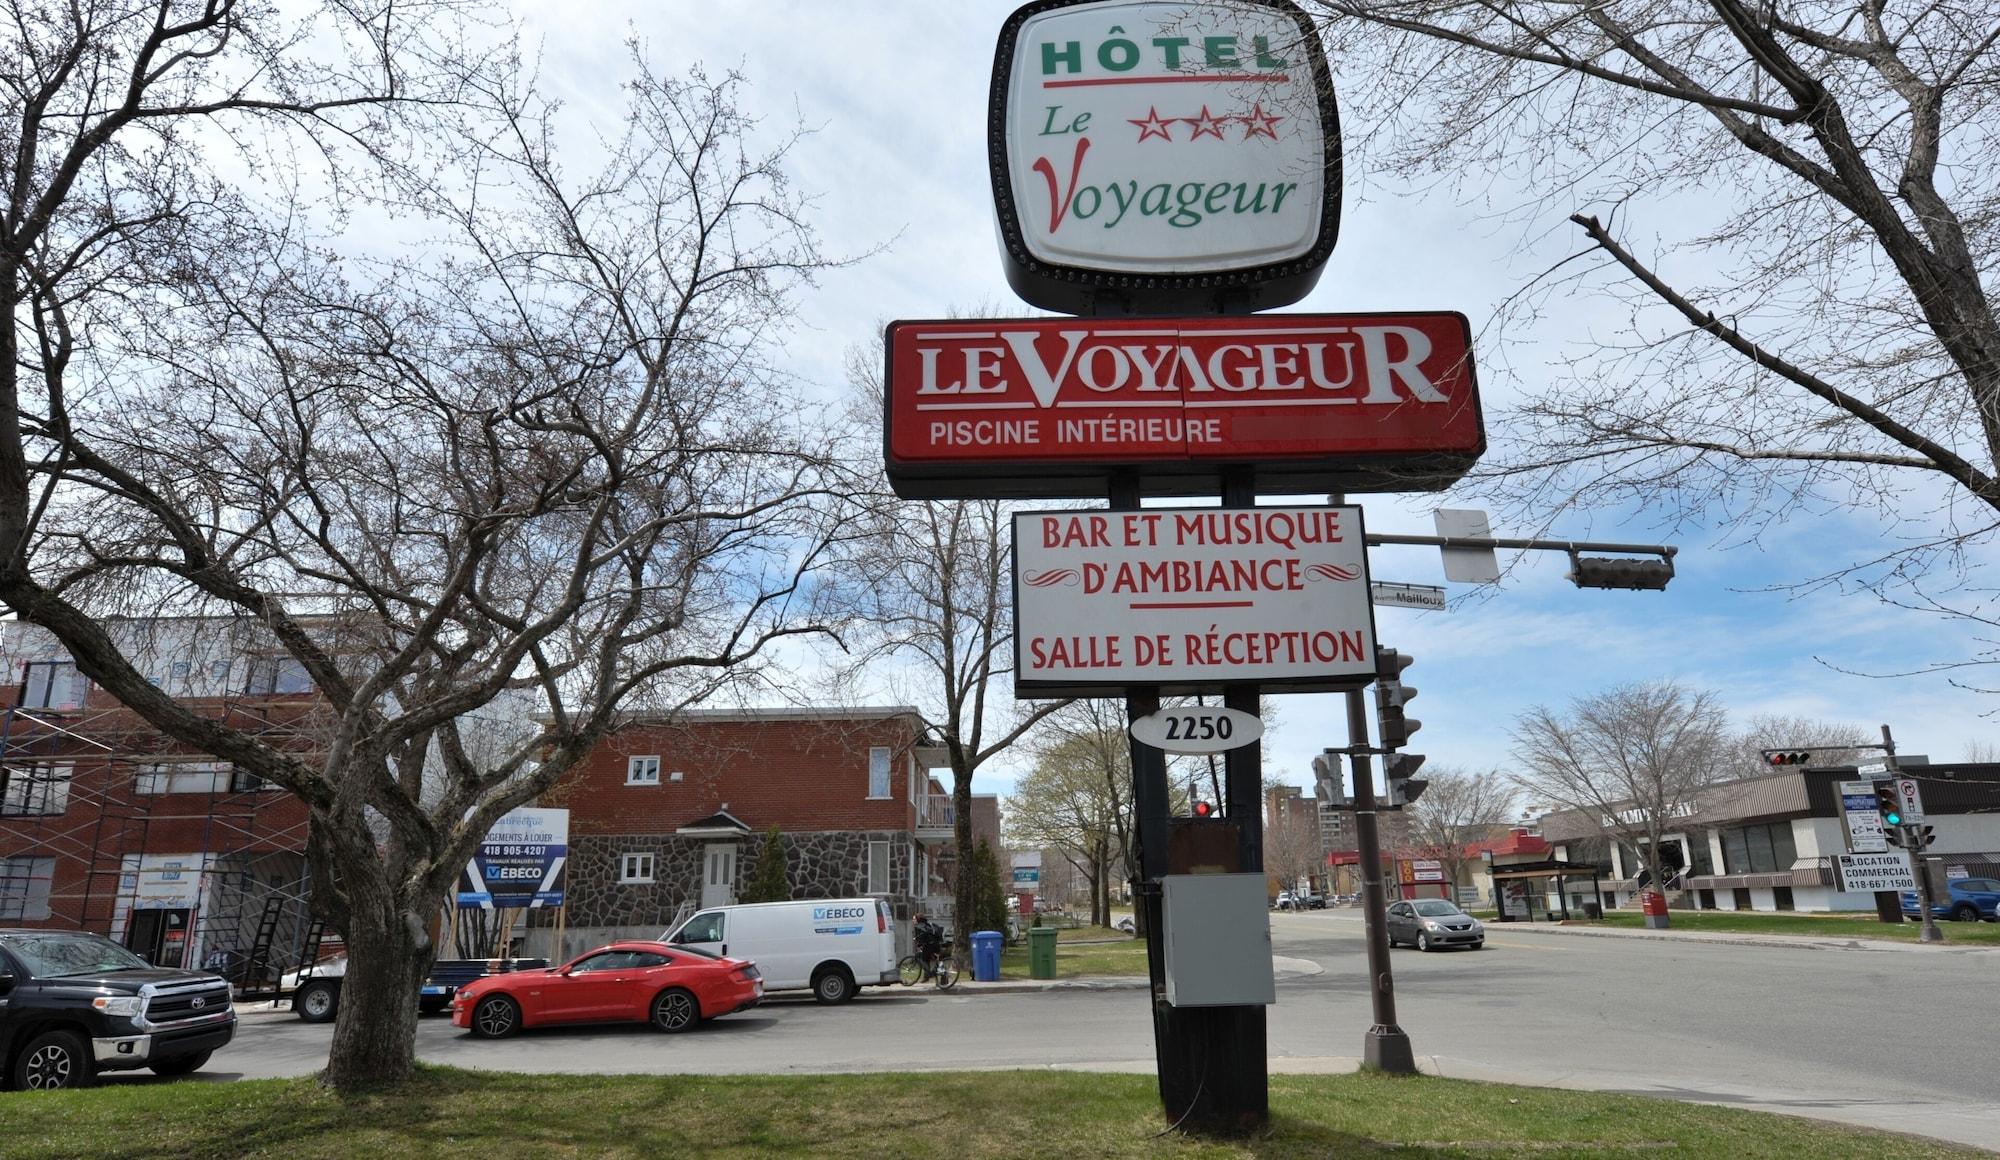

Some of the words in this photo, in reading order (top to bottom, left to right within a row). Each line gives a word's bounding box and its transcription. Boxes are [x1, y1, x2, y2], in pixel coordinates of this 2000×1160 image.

[1041, 26, 1287, 74] HÔTEL
[1038, 106, 1092, 136] Le
[1032, 137, 1297, 234] Voyageur
[917, 348, 1008, 395] LE
[1000, 325, 1450, 409] VOYAGEUR
[930, 420, 1040, 446] PISCINE
[1057, 413, 1222, 443] INTÉRIEURE
[1042, 516, 1111, 548] BAR
[1123, 514, 1162, 547] ET
[1174, 511, 1344, 549] MUSIQUE
[1083, 559, 1304, 594] D'AMBIANCE
[1031, 636, 1122, 669] SALLE
[1134, 634, 1173, 666] DE
[1184, 624, 1365, 665] RÉCEPTION
[1165, 716, 1233, 740] 2250
[484, 846, 501, 855] 418
[503, 846, 546, 855] 905-4207
[530, 834, 553, 842] LOUER
[1845, 867, 1911, 878] COMMERCIAL
[1852, 856, 1900, 866] LOCATION
